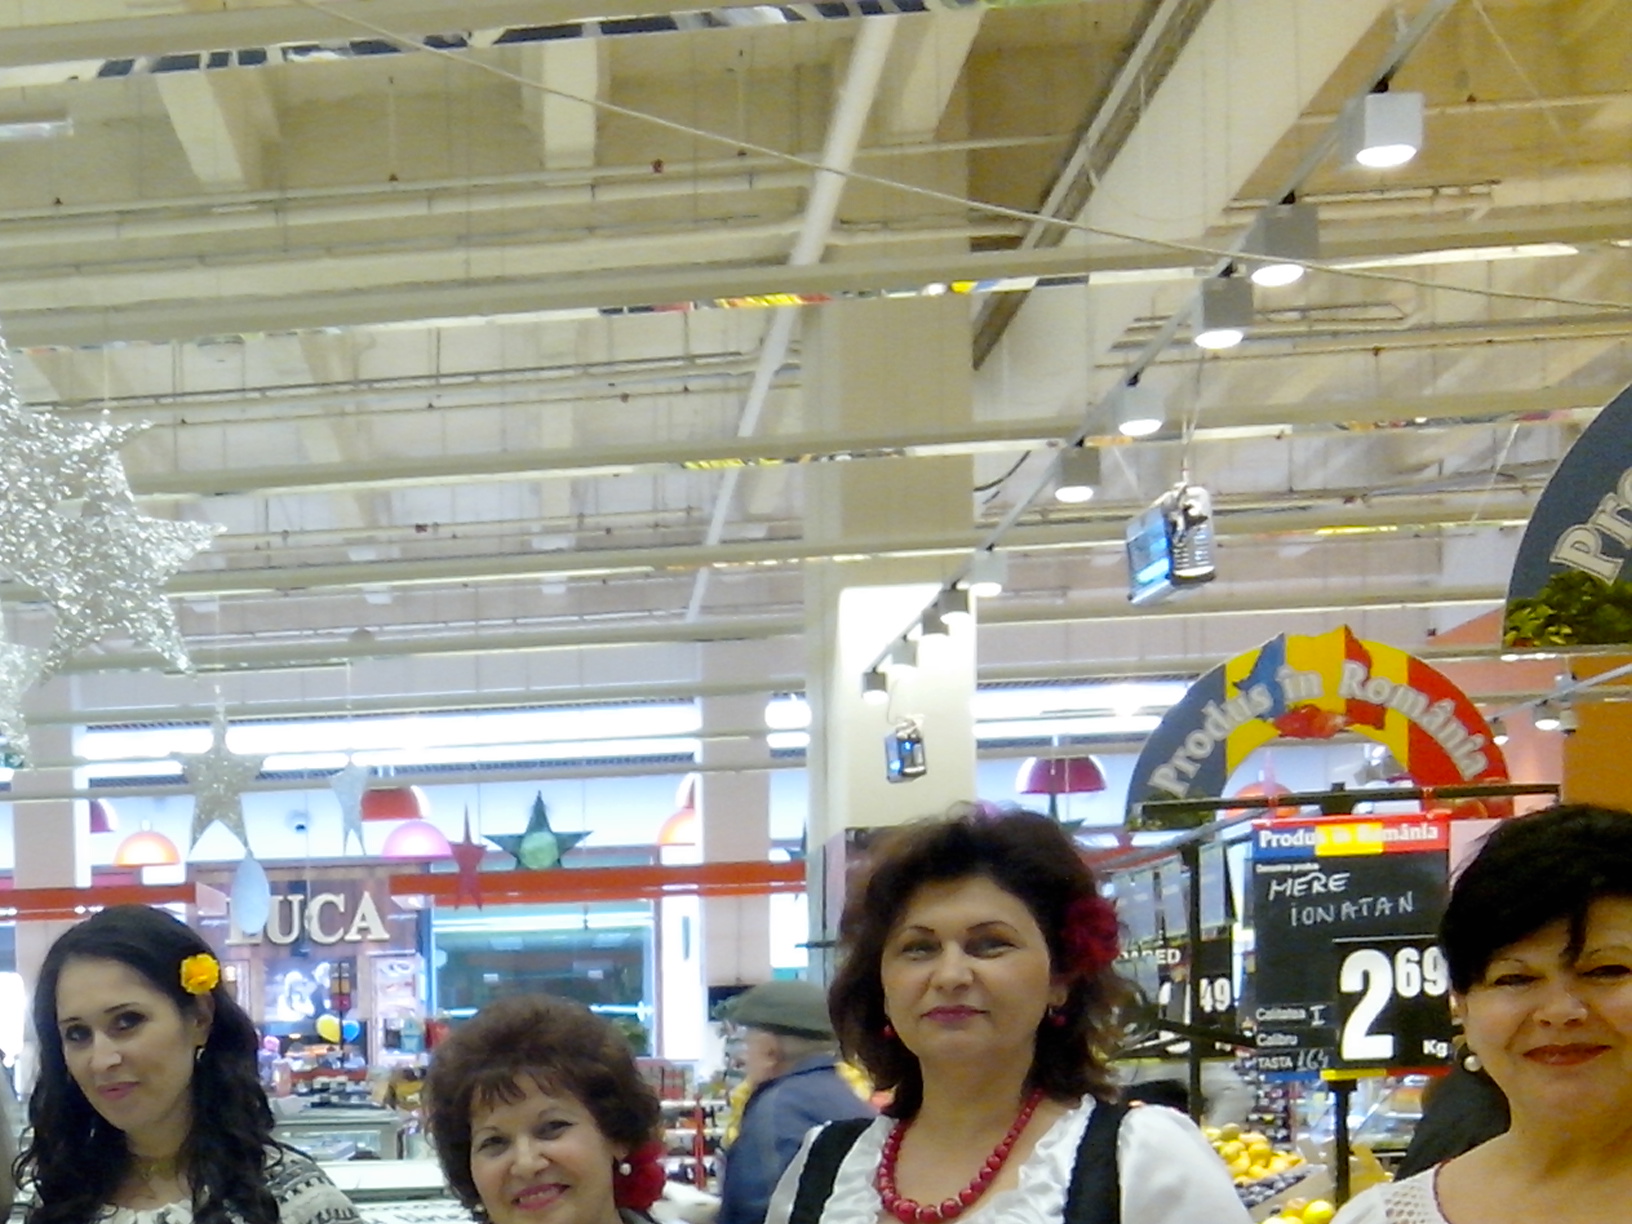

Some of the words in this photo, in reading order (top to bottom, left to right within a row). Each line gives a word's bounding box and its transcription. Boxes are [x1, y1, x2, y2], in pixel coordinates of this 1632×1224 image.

[1147, 680, 1274, 798] Produs
[1338, 659, 1489, 781] România
[1268, 870, 1352, 901] MERE
[1289, 891, 1415, 927] IONATAN
[1339, 947, 1395, 1061] 2
[1394, 945, 1450, 998] 69
[1422, 1038, 1450, 1059] Kg
